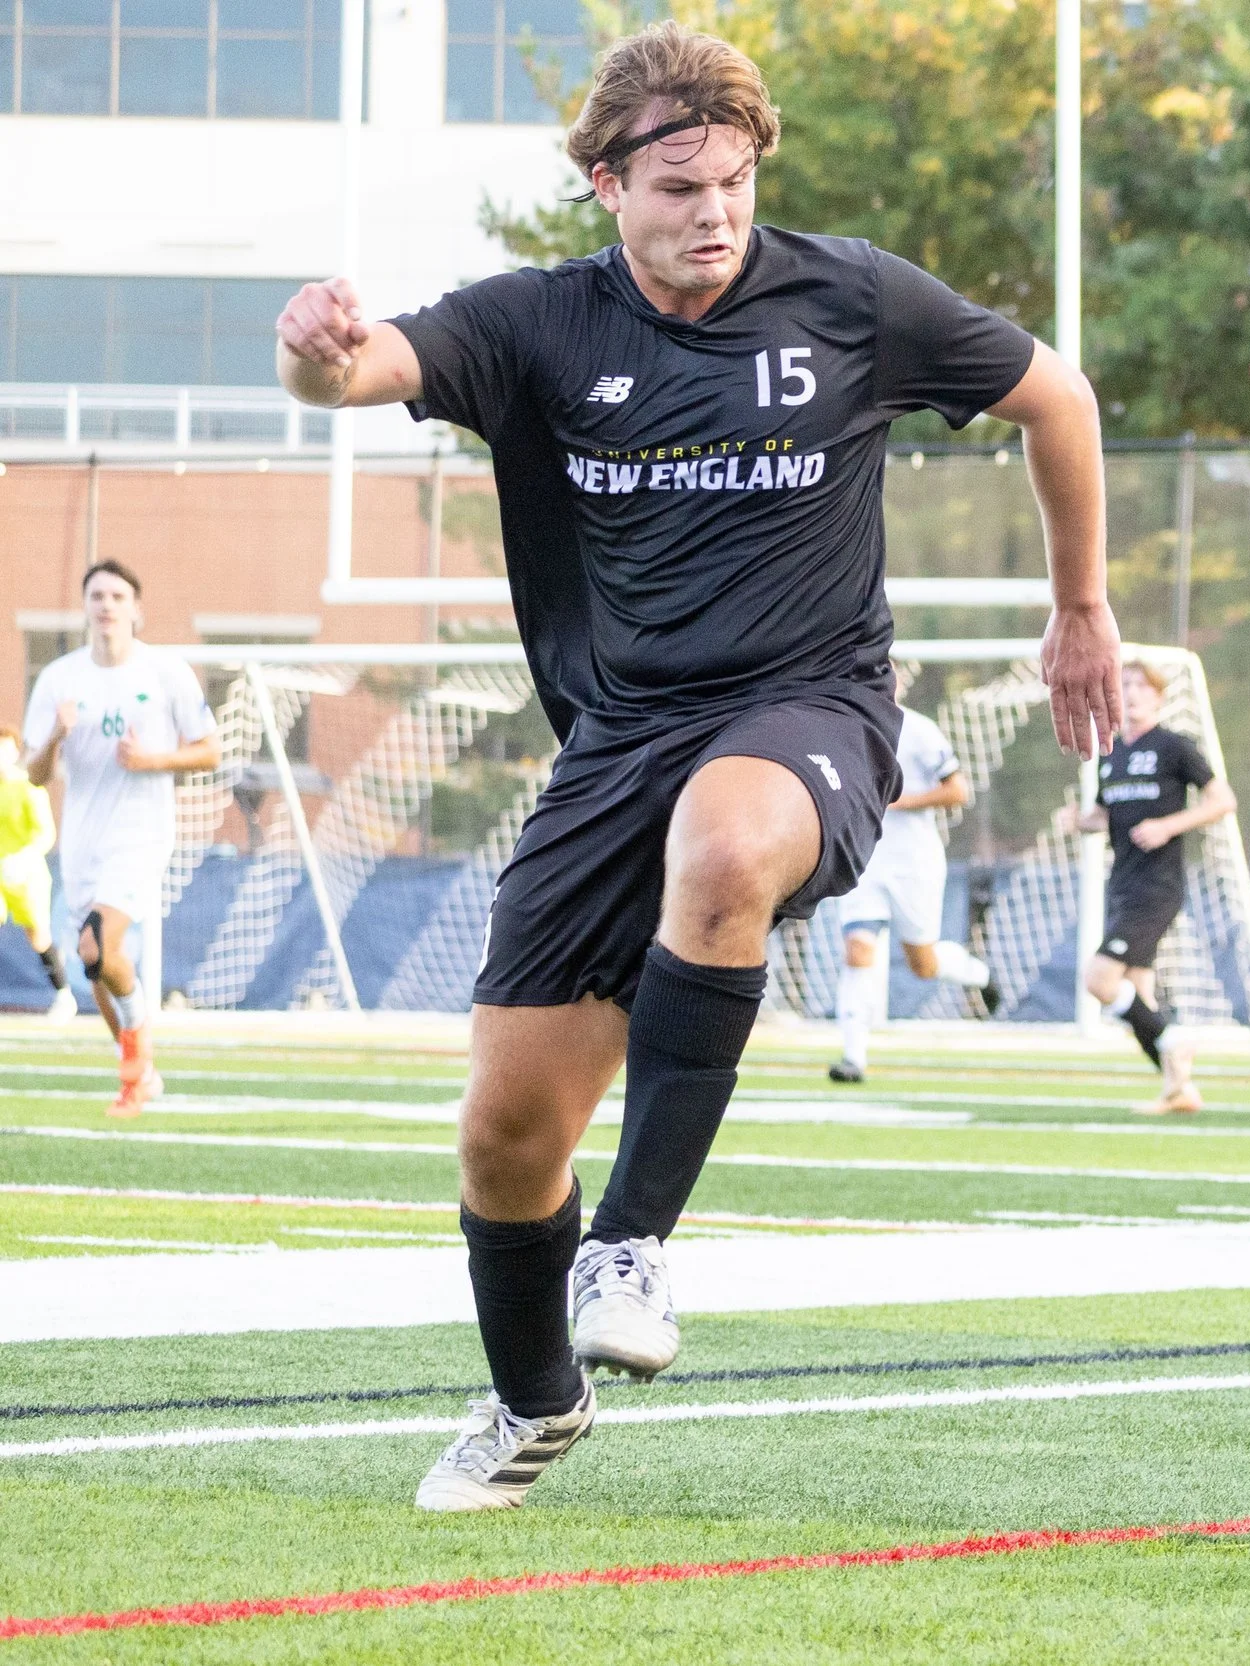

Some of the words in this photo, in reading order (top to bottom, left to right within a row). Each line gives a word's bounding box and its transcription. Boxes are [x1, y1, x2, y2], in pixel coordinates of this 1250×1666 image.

[755, 347, 817, 407] 15
[765, 439, 794, 451] OF
[566, 453, 643, 494] NEW
[649, 452, 825, 490] ENGLAND
[102, 708, 125, 737] 66
